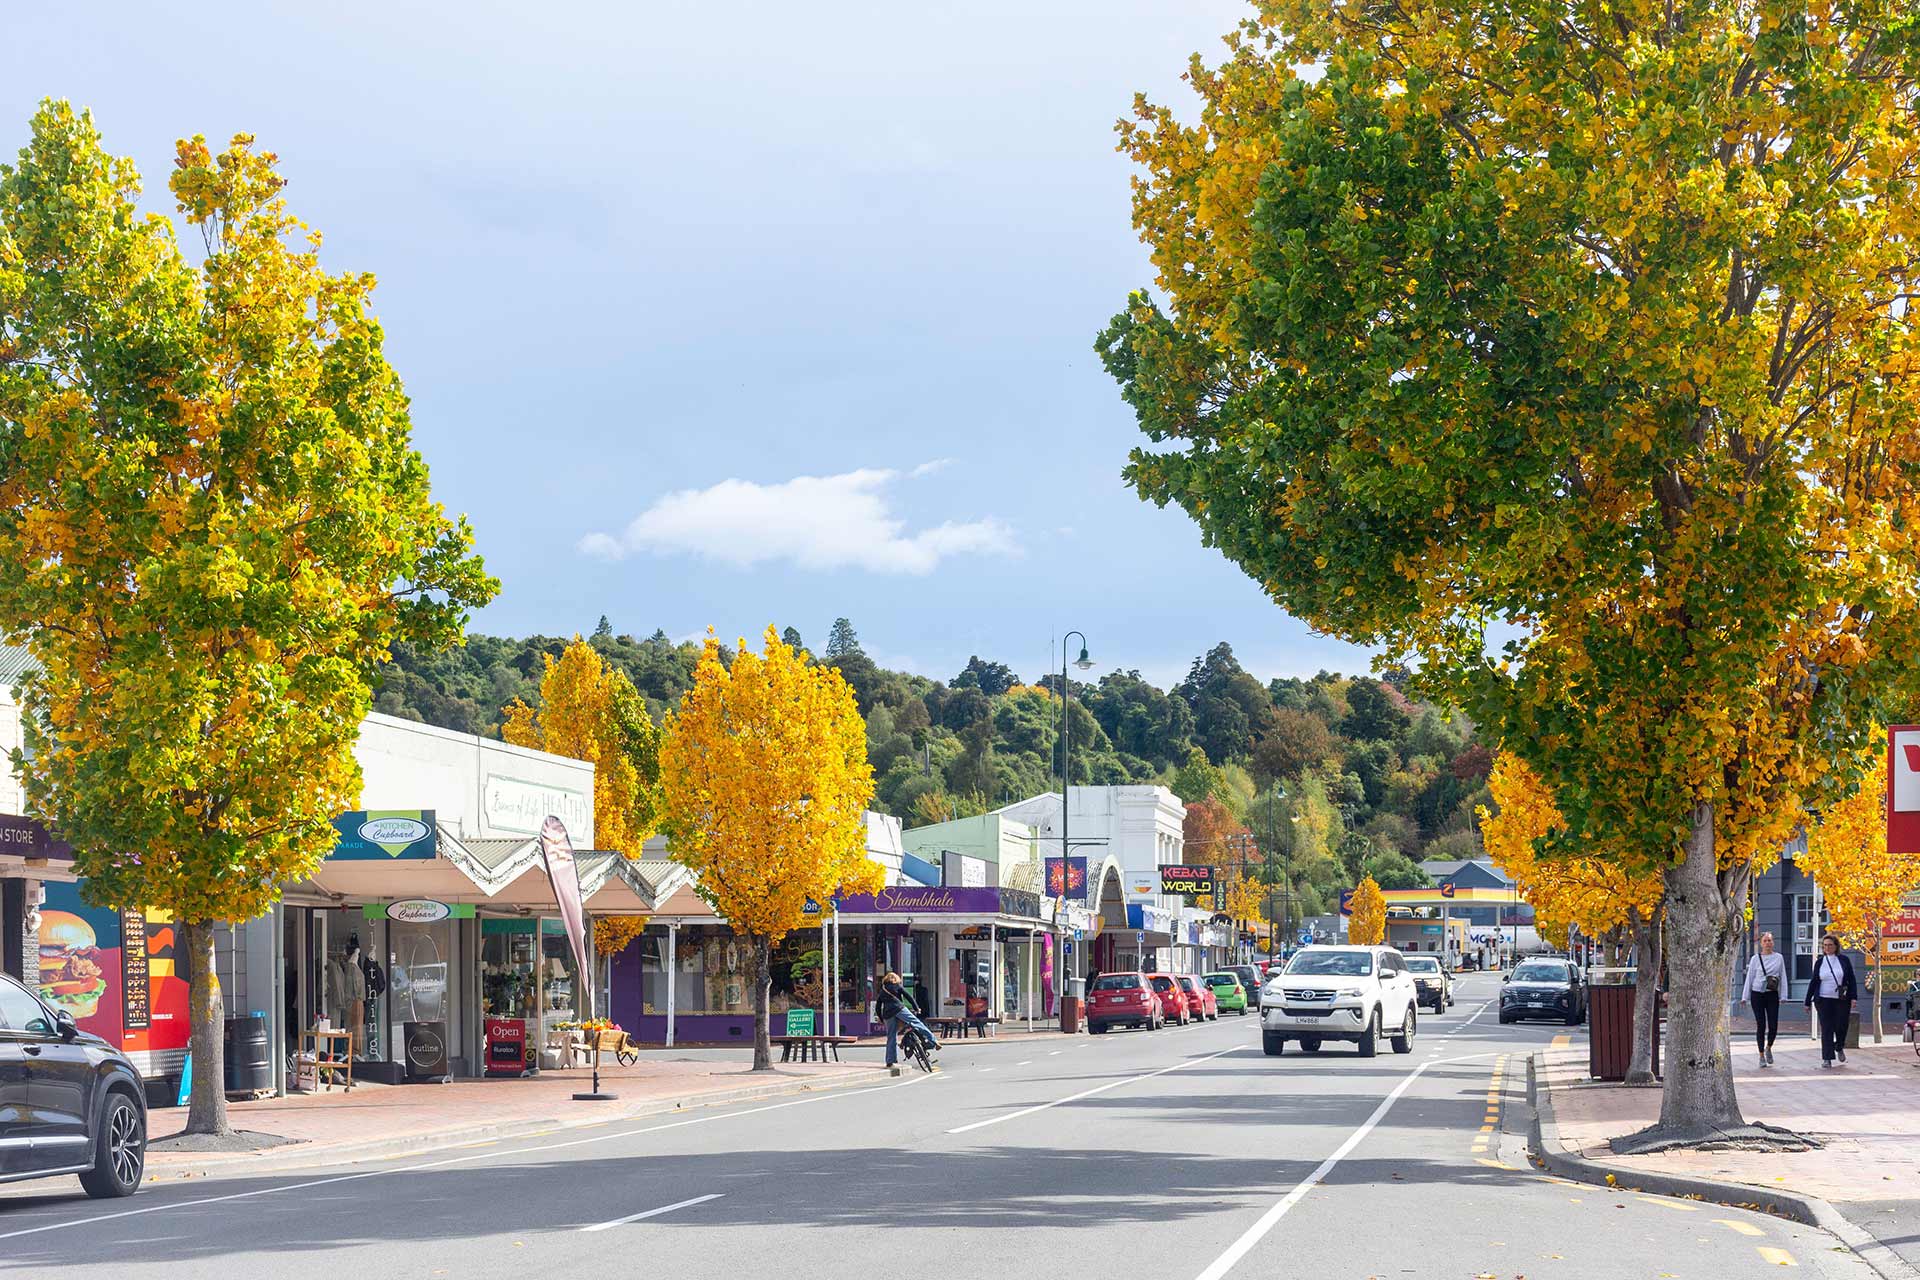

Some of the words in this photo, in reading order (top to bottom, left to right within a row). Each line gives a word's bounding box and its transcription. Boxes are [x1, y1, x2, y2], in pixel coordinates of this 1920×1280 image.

[380, 822, 414, 830] KITCHEN
[4, 828, 33, 844] STORE
[373, 829, 415, 840] Cupboard
[1163, 867, 1209, 879] KEBAB
[1162, 881, 1211, 893] WORLD
[874, 886, 954, 911] Shambhala
[405, 903, 436, 911] KITCHEN
[398, 910, 438, 920] Cupboard
[1890, 923, 1915, 933] MIC
[1892, 942, 1915, 950] QUIZ
[1880, 954, 1910, 962] NIGHT
[492, 1026, 519, 1038] Open
[413, 1044, 439, 1053] outline
